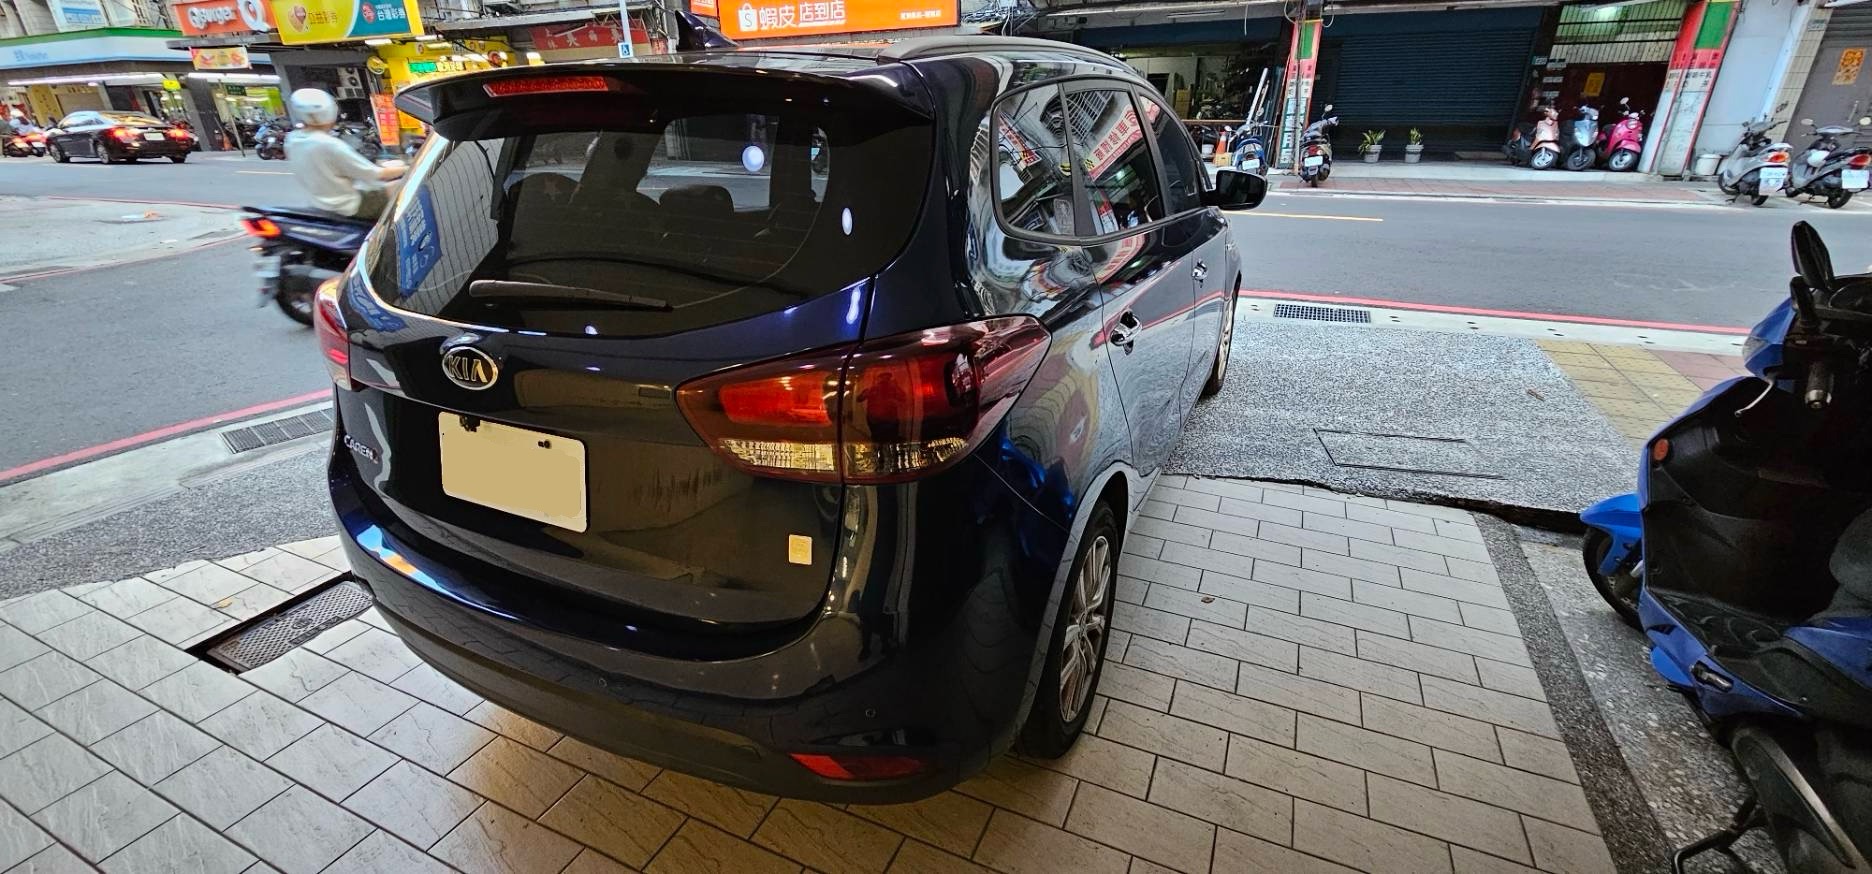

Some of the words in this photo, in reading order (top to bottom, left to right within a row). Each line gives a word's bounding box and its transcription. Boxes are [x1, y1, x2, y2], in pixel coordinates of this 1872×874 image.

[759, 5, 797, 31] 蝦皮
[799, 0, 846, 21] 店到店
[449, 356, 488, 384] KIA
